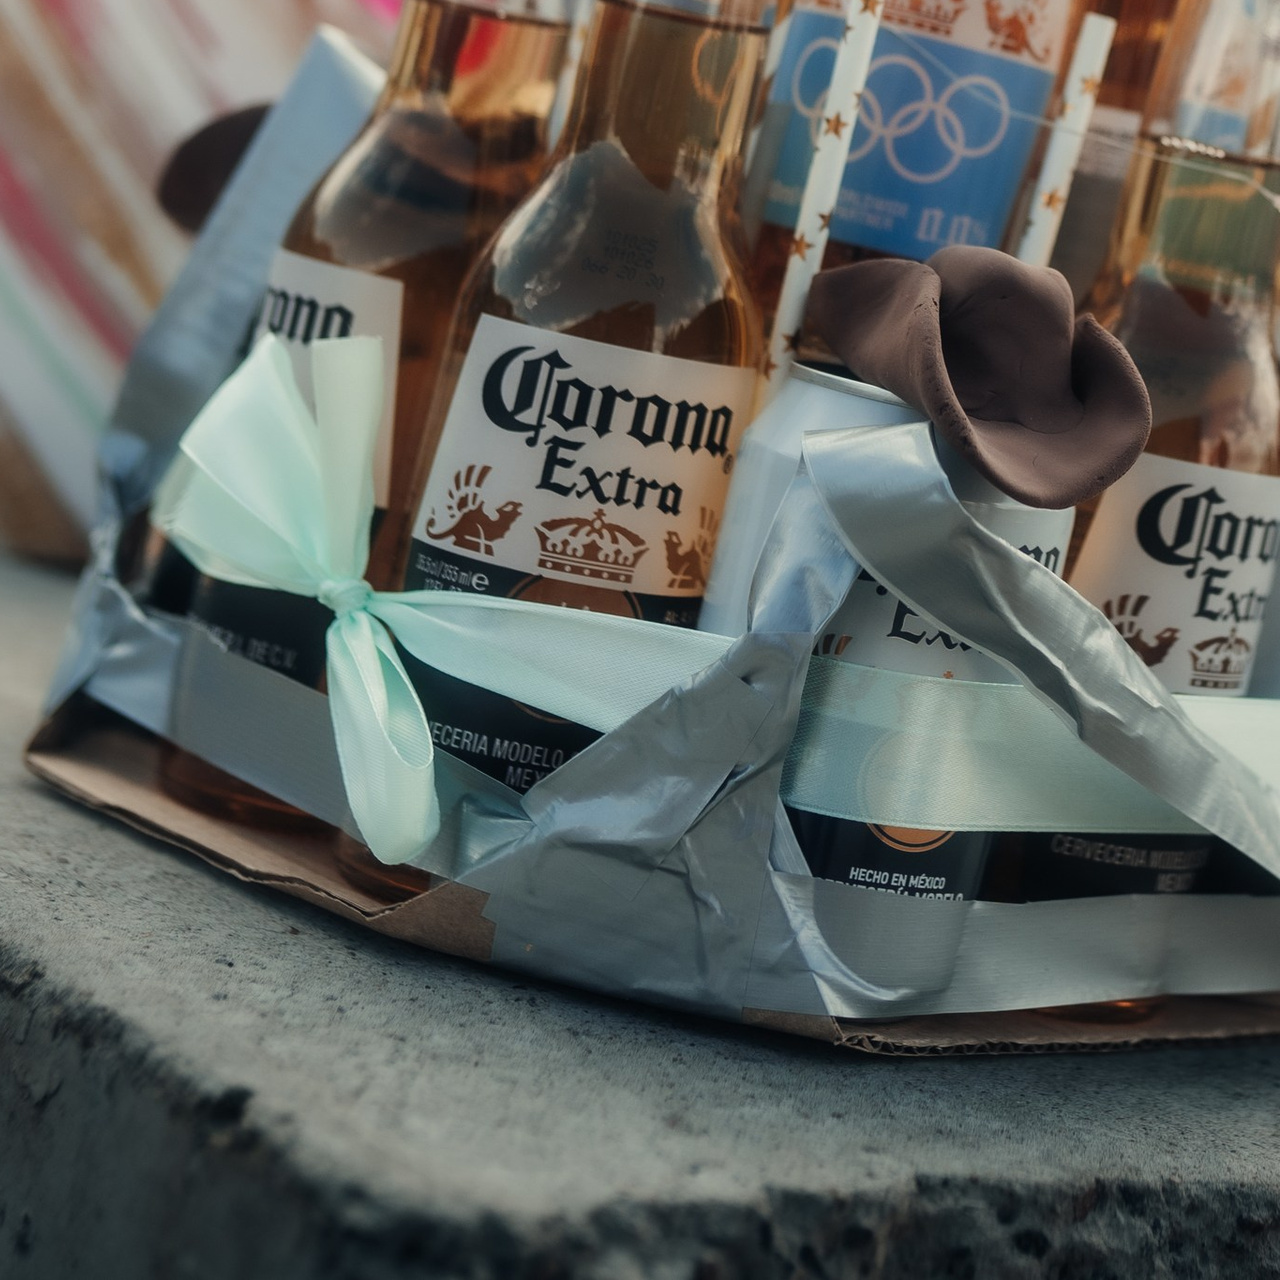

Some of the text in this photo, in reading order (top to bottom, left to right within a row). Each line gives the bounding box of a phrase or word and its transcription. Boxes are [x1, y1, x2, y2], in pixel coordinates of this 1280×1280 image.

[482, 345, 734, 458] Corona
[535, 435, 683, 516] Extra
[1135, 483, 1277, 579] Coro
[430, 721, 564, 769] ECERIA MODELO
[849, 866, 890, 885] HECHO
[891, 873, 908, 887] EN
[909, 873, 946, 889] MÉXICO
